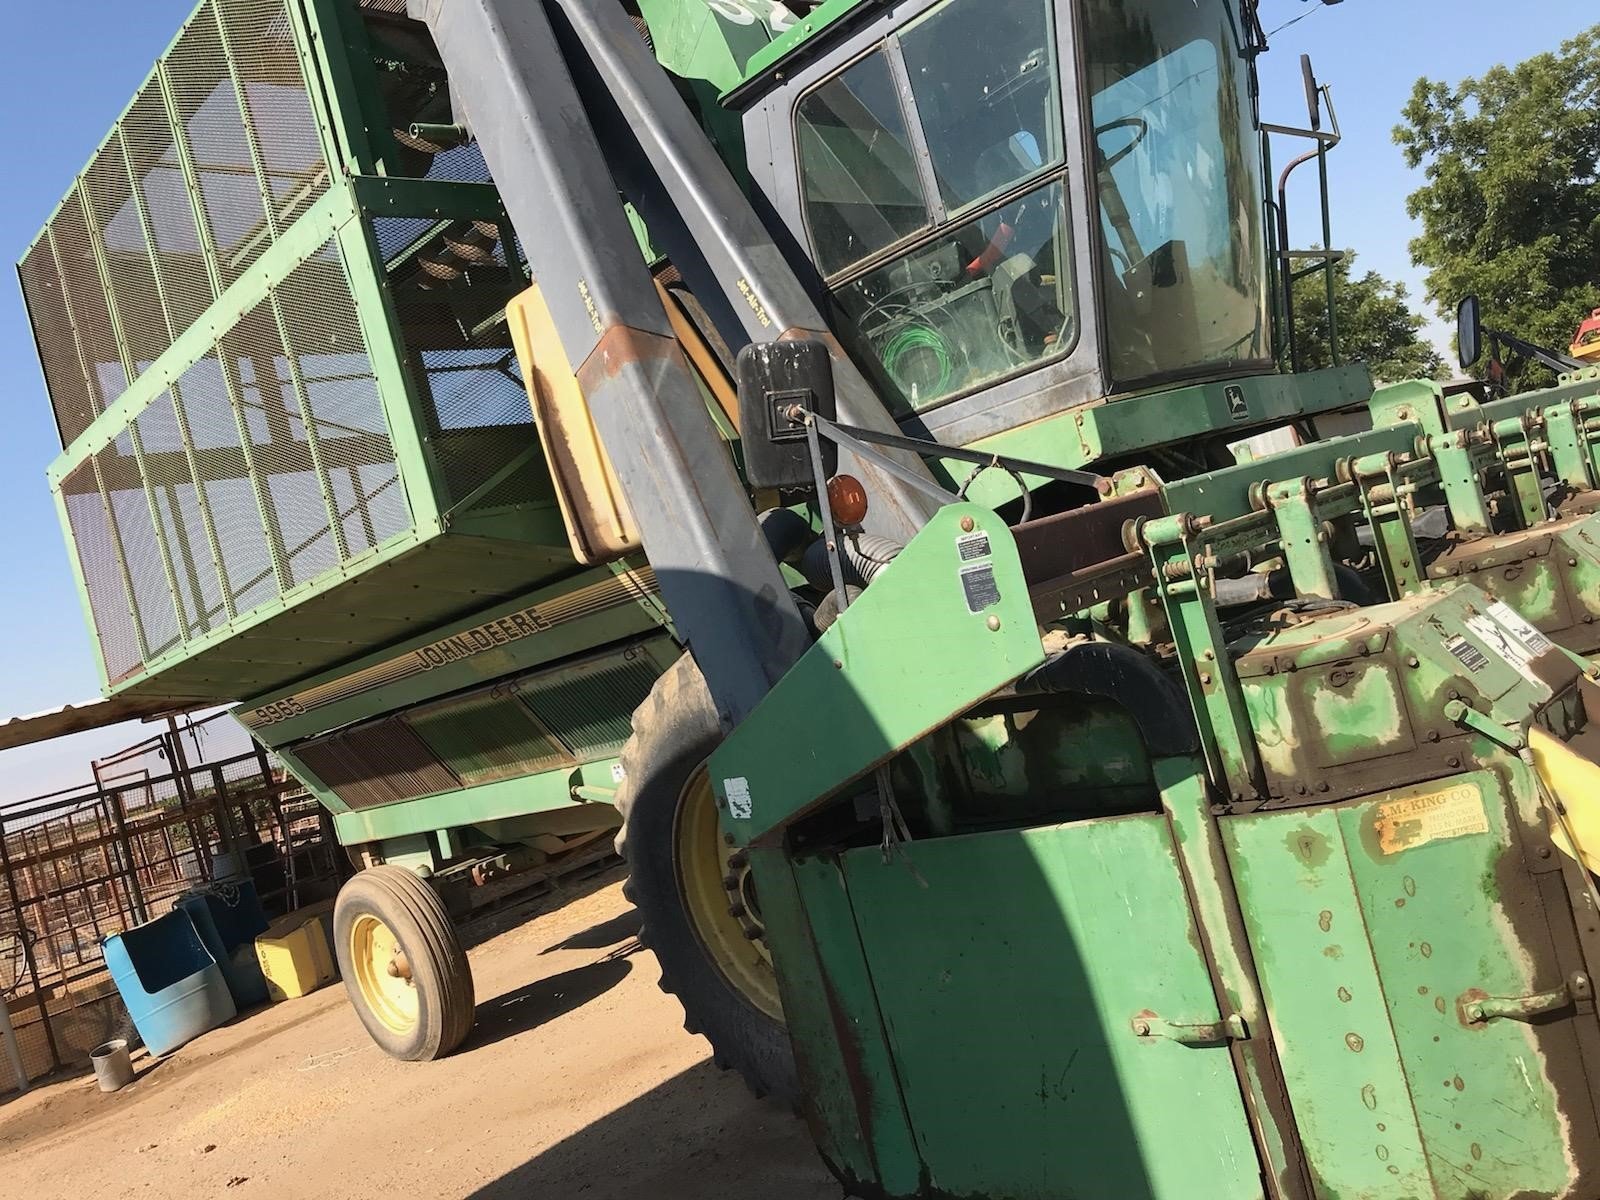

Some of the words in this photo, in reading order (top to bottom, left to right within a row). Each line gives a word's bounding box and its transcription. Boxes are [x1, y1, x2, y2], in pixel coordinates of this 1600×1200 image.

[736, 279, 771, 328] Jet-Air-Trol
[415, 636, 474, 669] JOHN
[468, 608, 551, 651] DEERE
[256, 697, 305, 723] 9965
[1410, 794, 1447, 811] KING
